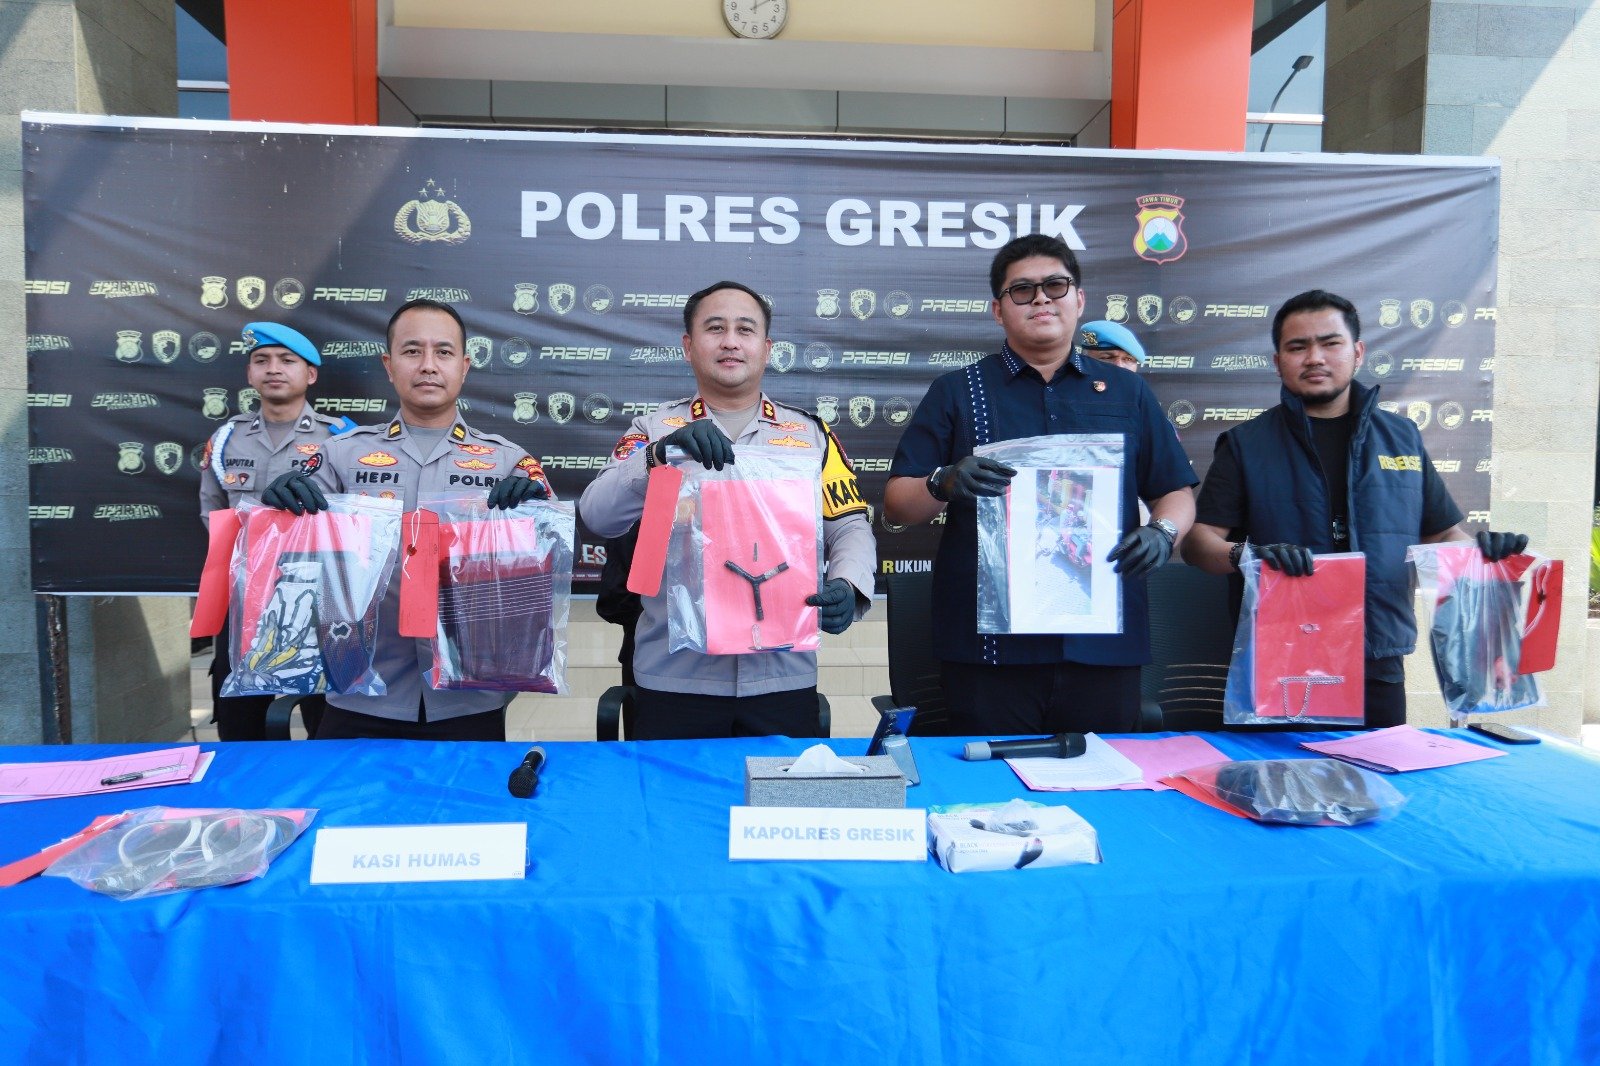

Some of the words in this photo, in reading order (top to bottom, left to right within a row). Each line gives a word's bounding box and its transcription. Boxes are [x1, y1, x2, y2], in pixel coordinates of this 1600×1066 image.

[1160, 196, 1179, 205] TIMUR
[521, 190, 801, 245] POLRES
[825, 198, 1087, 251] GRESIK
[313, 287, 387, 302] PRESISI
[622, 294, 691, 308] PRESIS
[921, 299, 989, 313] PRESISI
[1204, 304, 1269, 318] PRESISI
[540, 346, 612, 360] PRESISI
[841, 351, 910, 365] PRESISI
[1138, 356, 1194, 368] RESISI
[1401, 358, 1465, 371] PRESISI
[314, 398, 387, 412] PRESISI
[226, 459, 255, 468] SAPUTRA
[355, 470, 400, 484] HEPI
[882, 559, 932, 574] RUKUN
[743, 825, 840, 841] KAPOLRES
[846, 827, 916, 842] GRESIK
[352, 853, 401, 869] KASI
[408, 852, 481, 868] HUMAS
